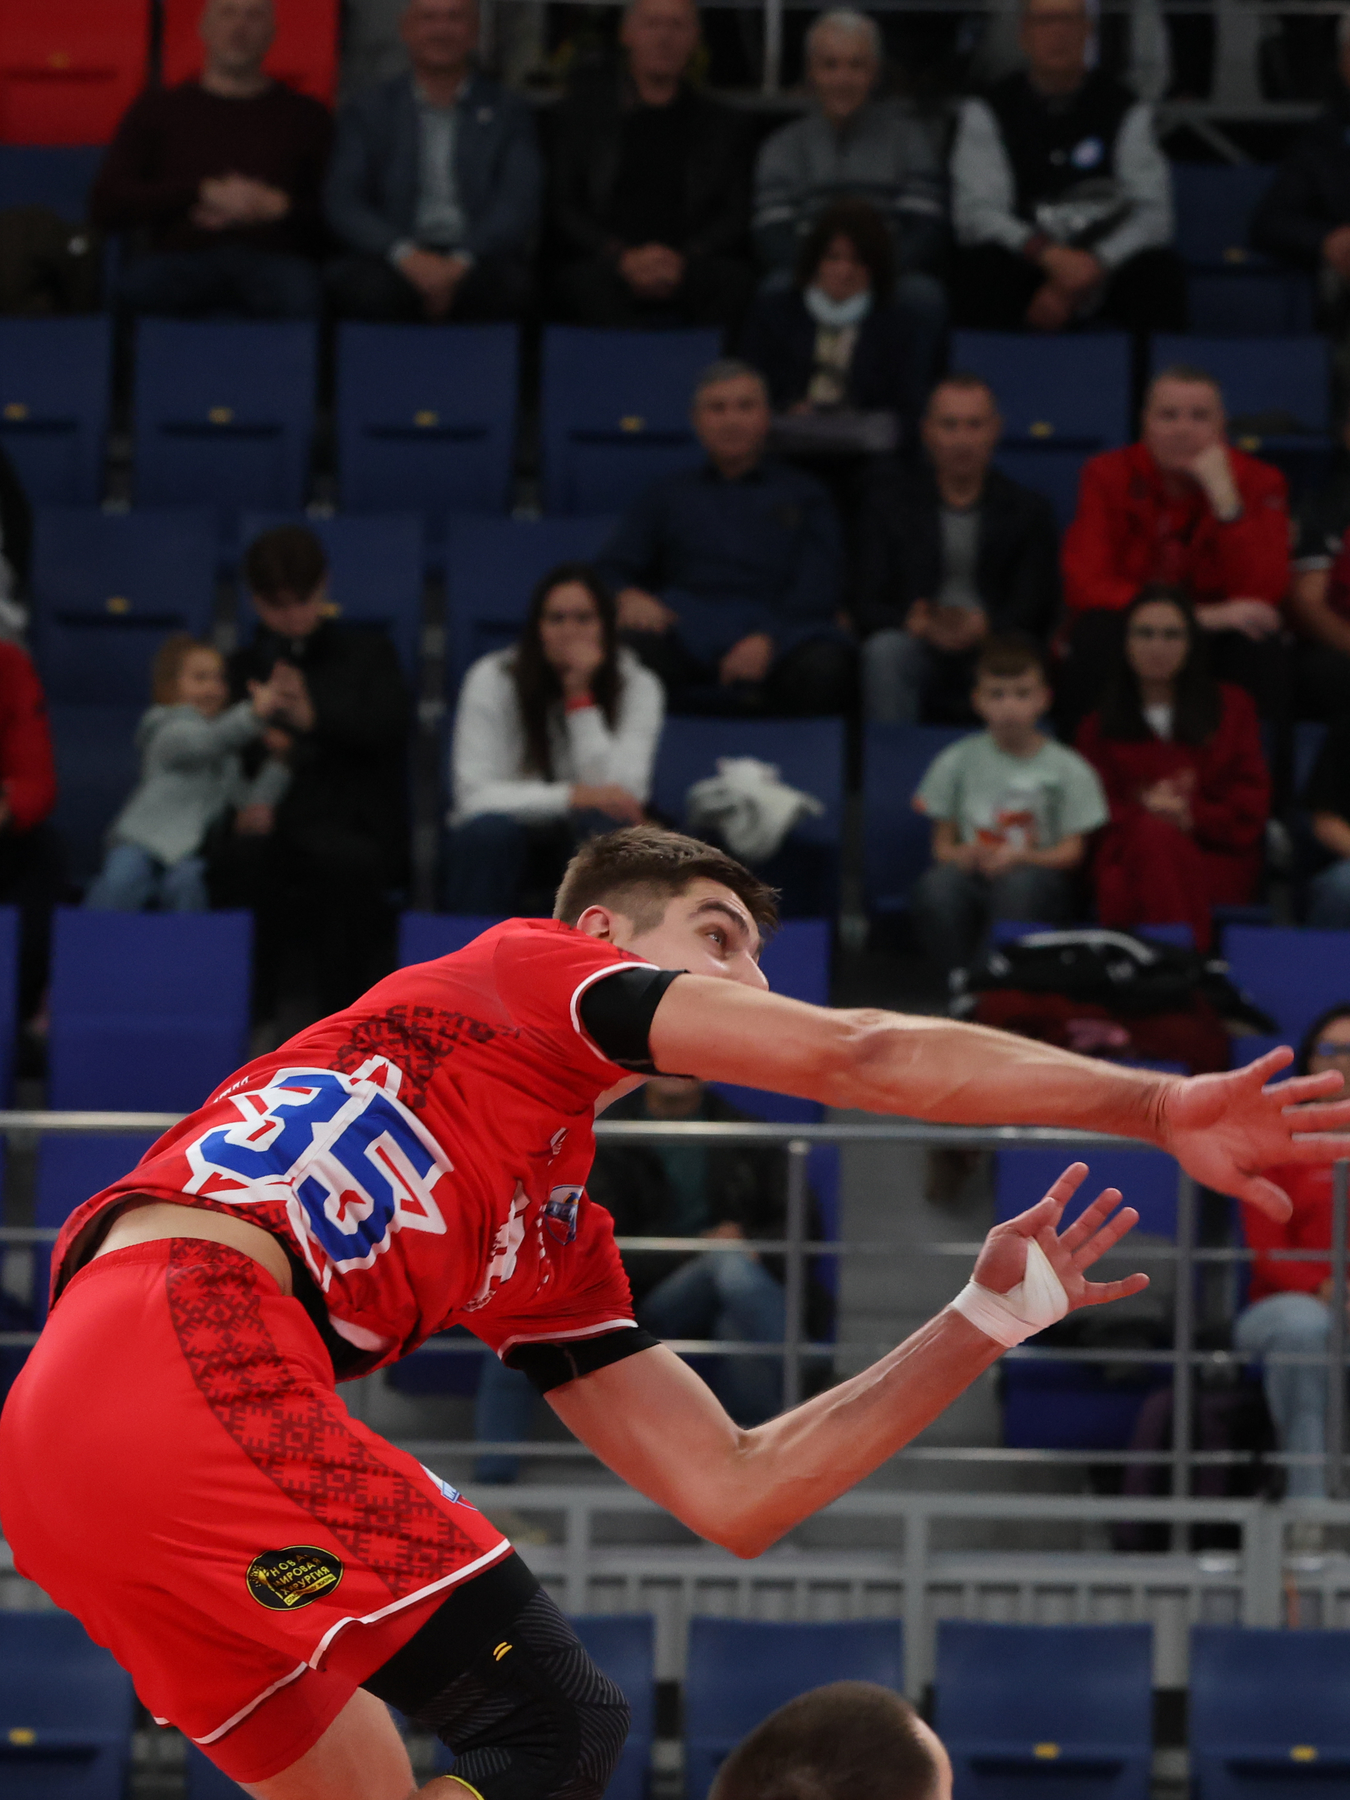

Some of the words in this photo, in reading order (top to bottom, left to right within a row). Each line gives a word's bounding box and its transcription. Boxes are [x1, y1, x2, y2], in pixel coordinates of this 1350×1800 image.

[184, 1056, 454, 1282] 35
[269, 1554, 311, 1577] НОВА
[280, 1565, 331, 1596] ХИРУРГИЯ
